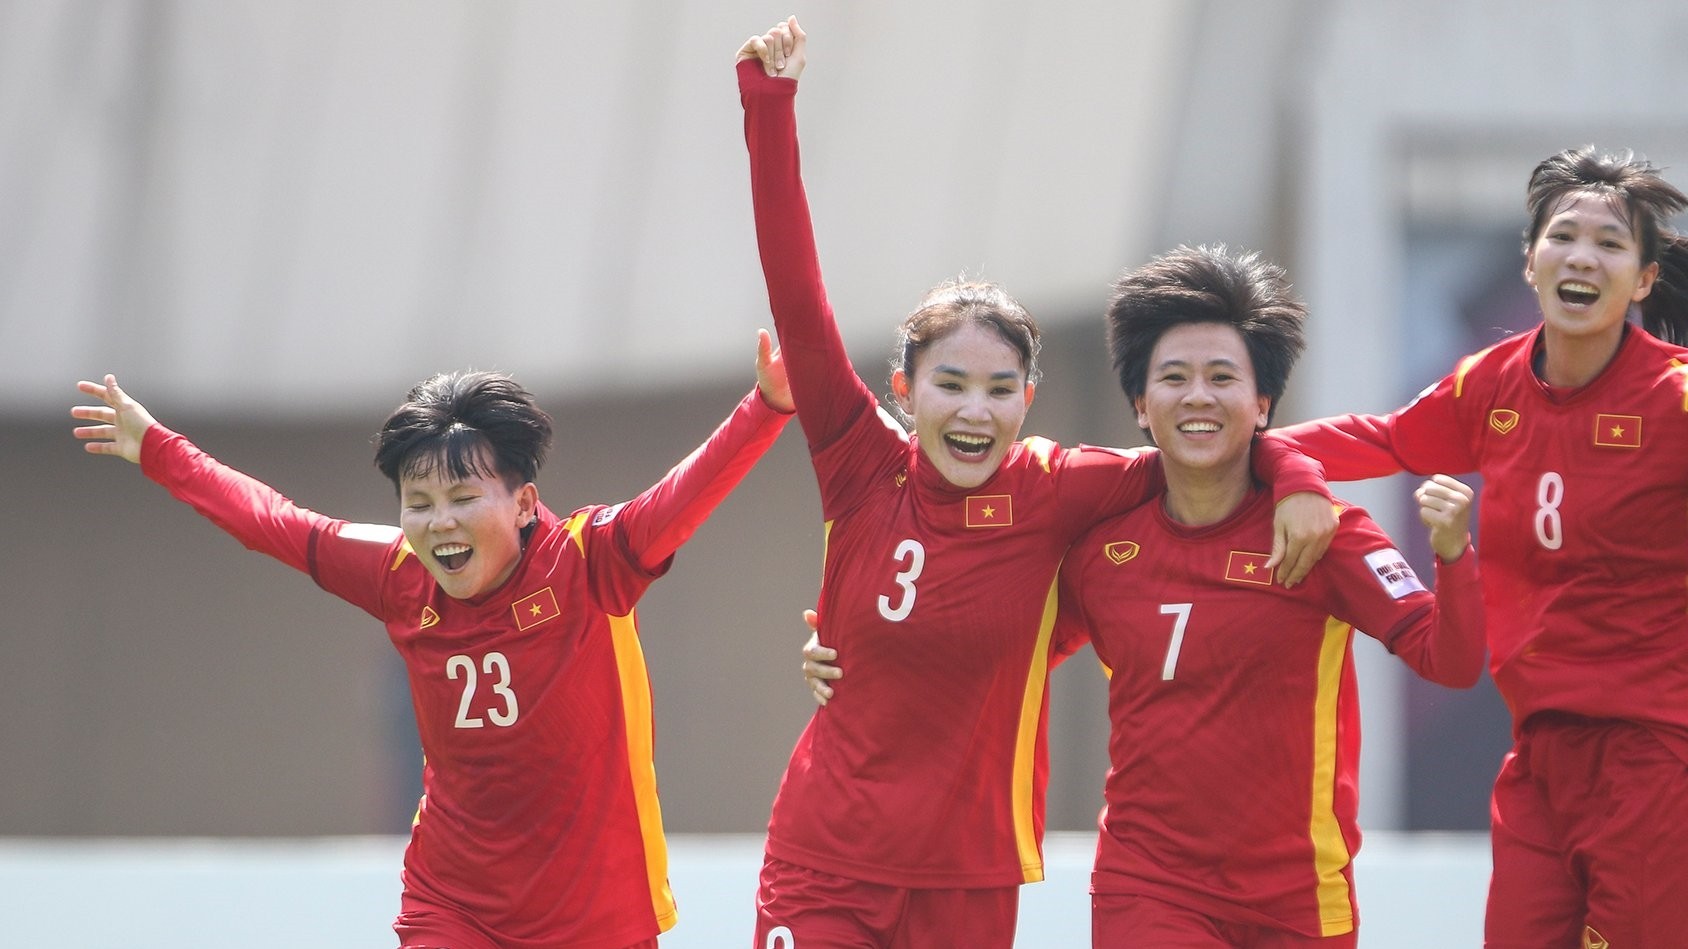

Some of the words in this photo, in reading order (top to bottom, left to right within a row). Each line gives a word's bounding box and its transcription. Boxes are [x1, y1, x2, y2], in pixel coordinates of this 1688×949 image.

[1534, 471, 1564, 550] 8
[877, 538, 926, 622] 3
[1159, 602, 1193, 681] 7
[446, 651, 519, 729] 23
